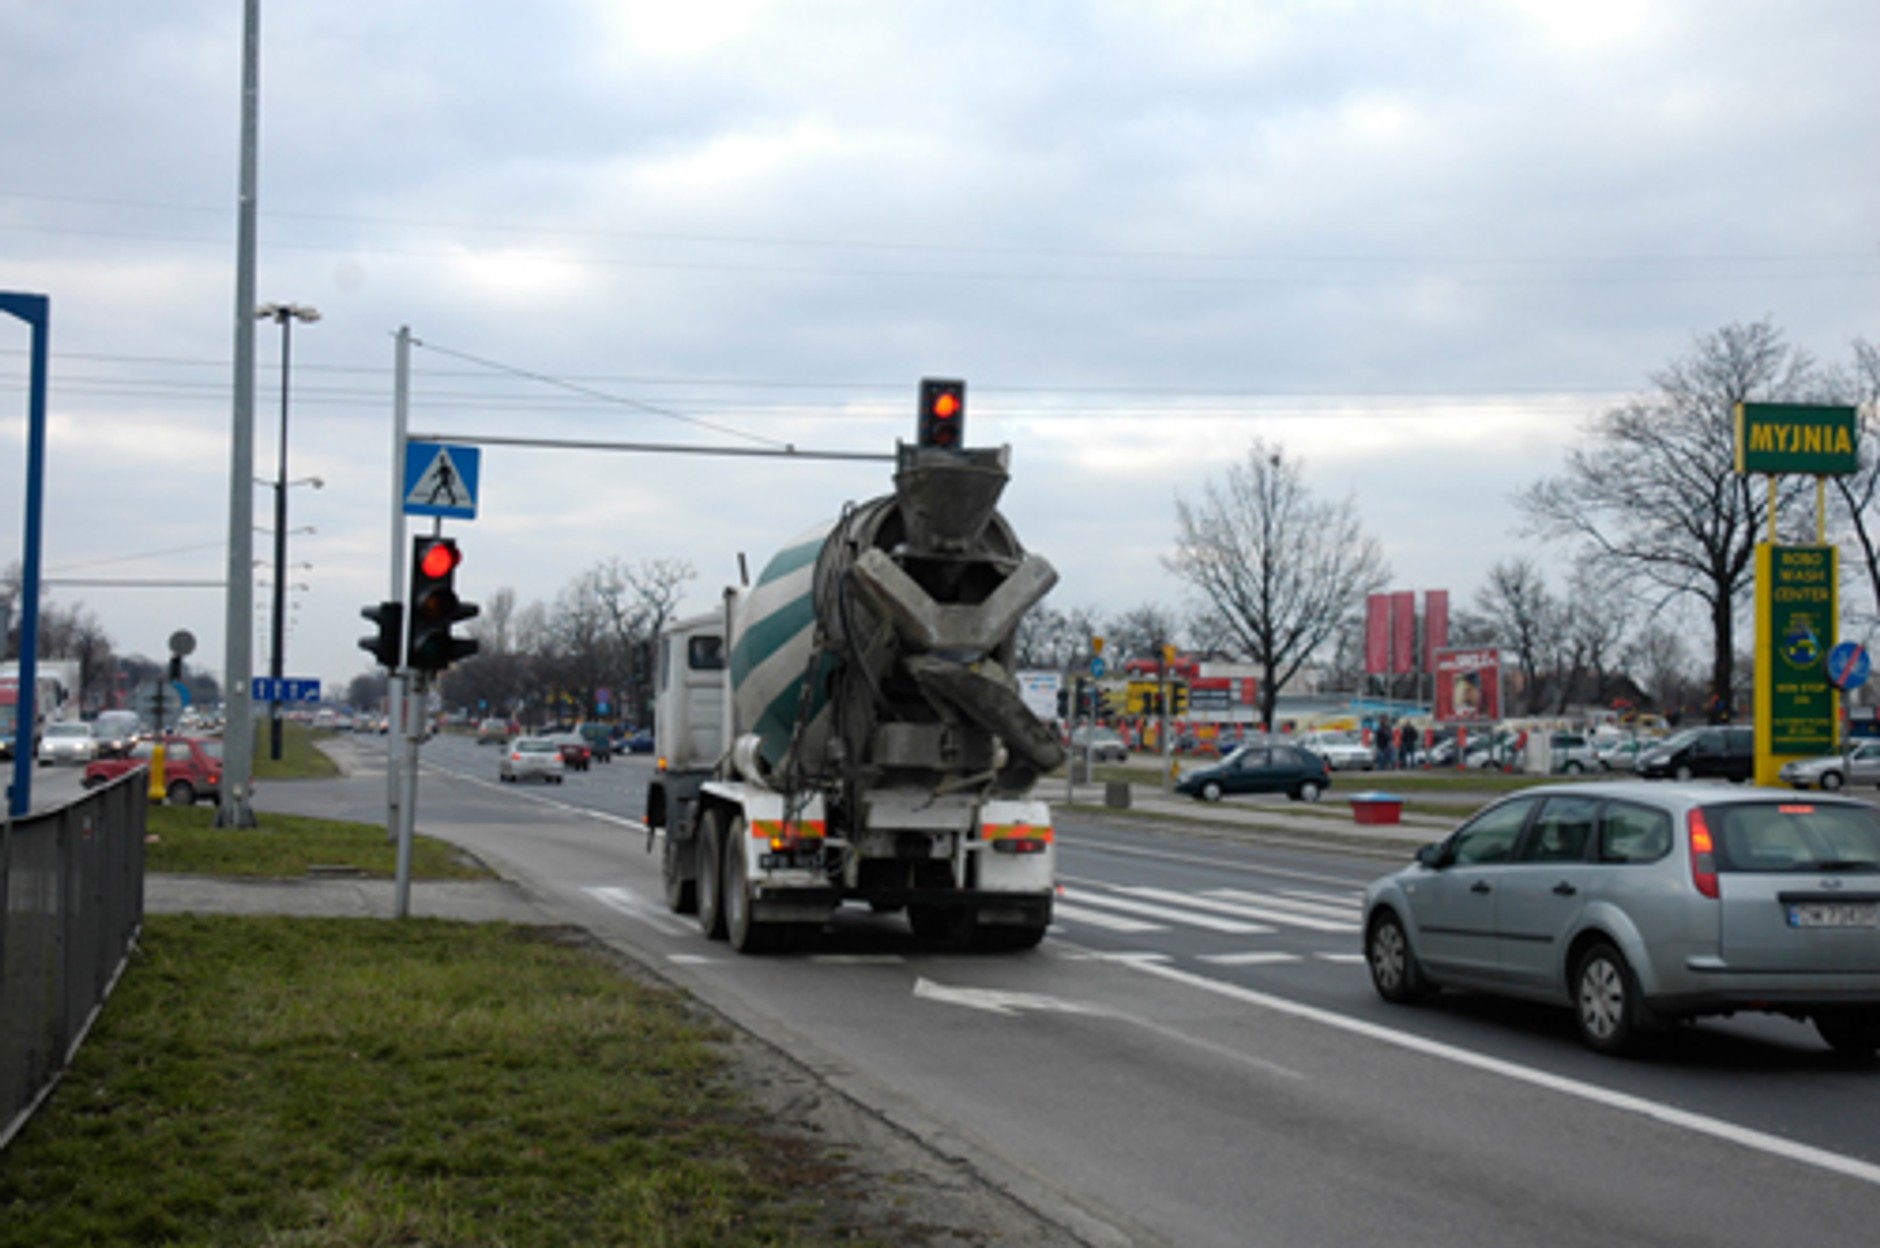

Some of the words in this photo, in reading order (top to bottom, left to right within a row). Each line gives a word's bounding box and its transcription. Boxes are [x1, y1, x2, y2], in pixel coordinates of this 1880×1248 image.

[1749, 423, 1853, 453] MYJNIA
[1782, 552, 1823, 566] ROBO
[1780, 569, 1825, 582] WASH
[1775, 587, 1829, 602] CENTER
